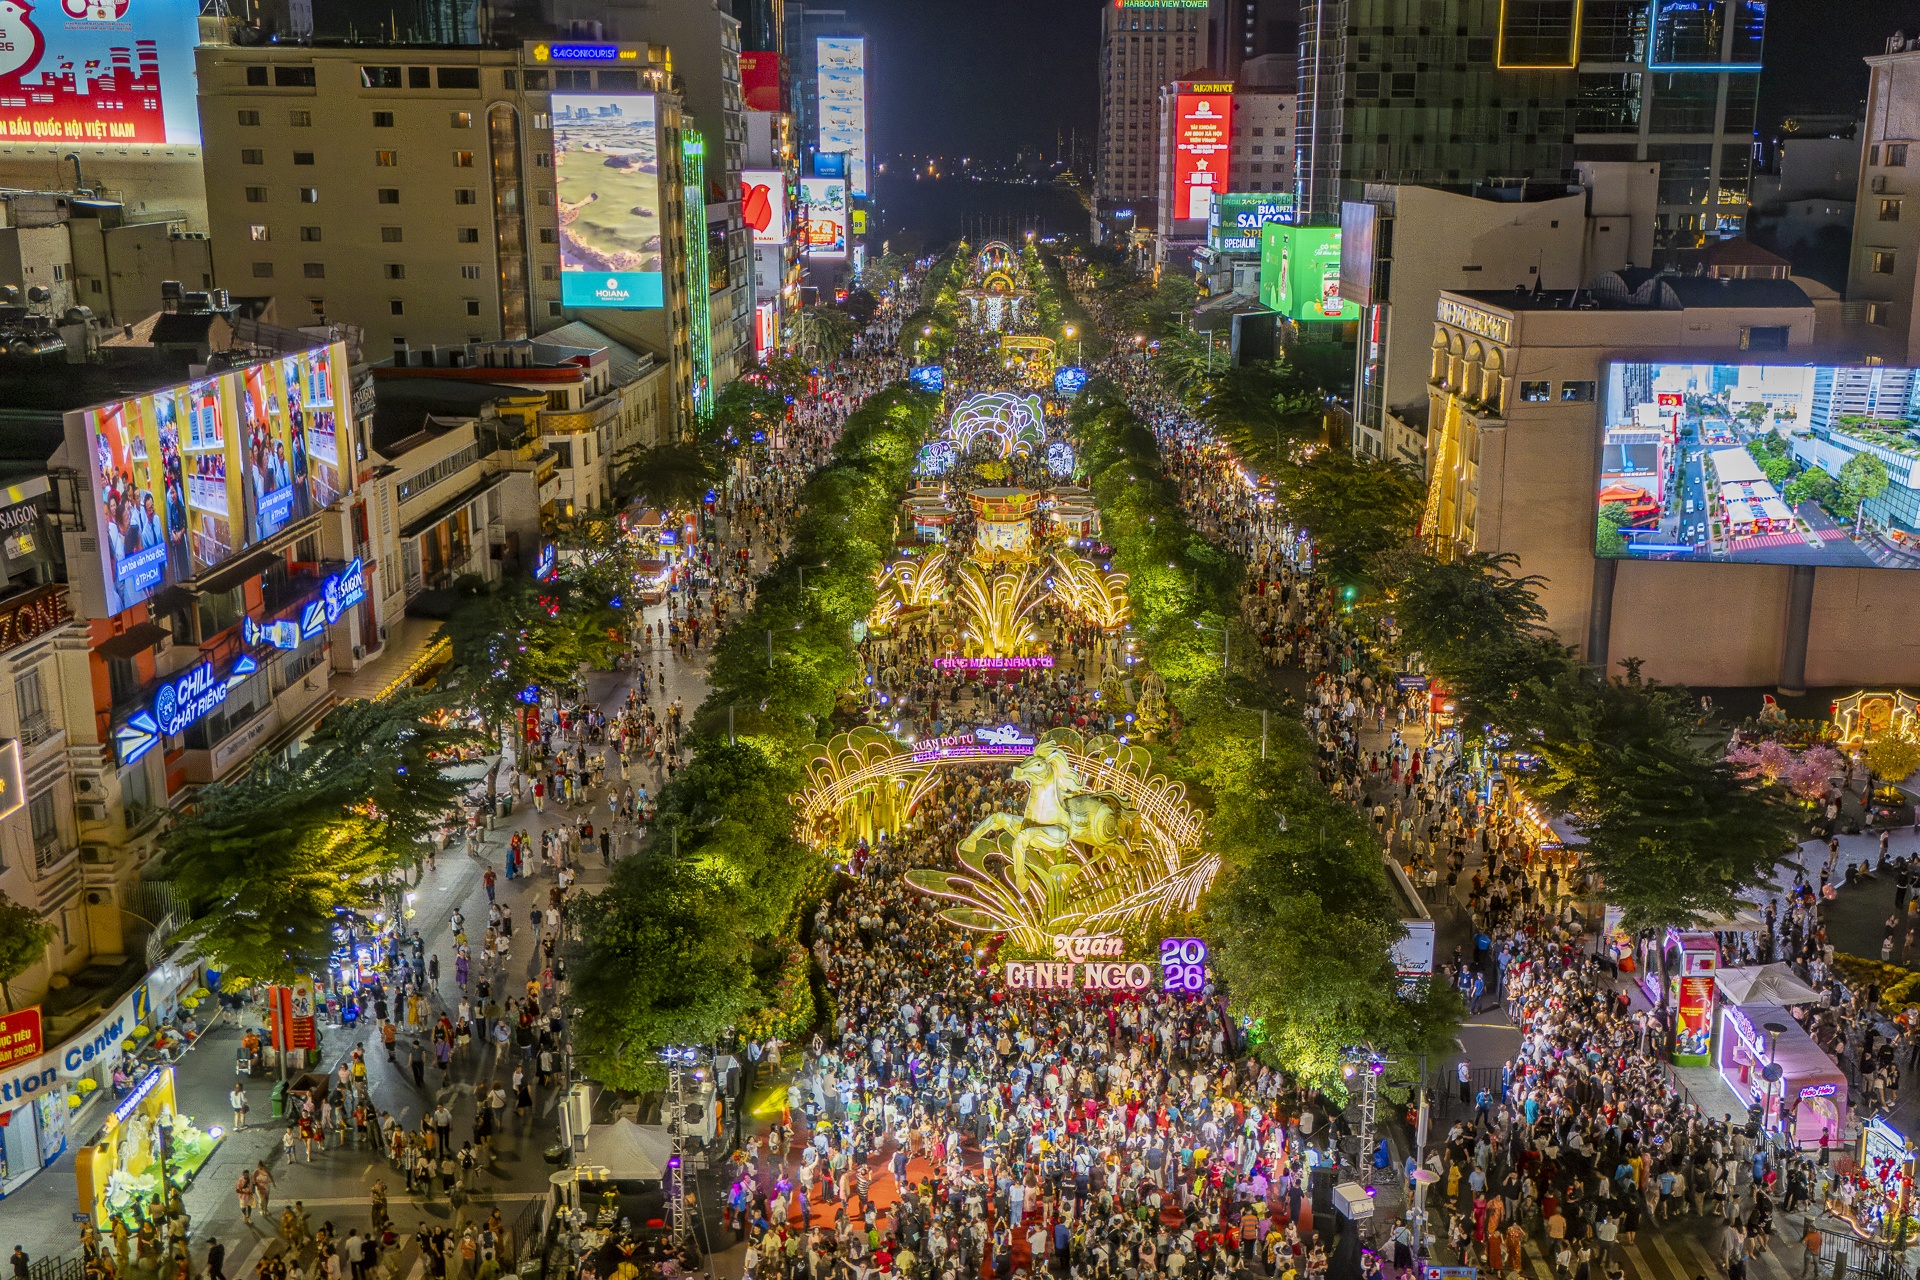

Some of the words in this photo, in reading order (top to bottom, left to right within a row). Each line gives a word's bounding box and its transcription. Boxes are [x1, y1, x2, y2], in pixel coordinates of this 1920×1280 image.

[1124, 0, 1159, 8] HARBOUR
[1161, 0, 1179, 8] VIEW
[1182, 0, 1209, 8] TOWER
[553, 48, 616, 58] SAIGONTOURIST
[1193, 83, 1212, 93] SAIGON
[1213, 83, 1233, 93] PRINCE
[9, 117, 31, 136] BẦU
[33, 117, 62, 137] QUỐC
[64, 119, 83, 139] HỘI
[84, 120, 107, 140] VIỆT
[109, 122, 136, 138] NAM
[1258, 206, 1275, 214] BIA
[0, 504, 38, 530] SAIGON
[340, 573, 363, 597] SAIGON
[0, 589, 74, 652] ZONE
[1005, 656, 1031, 668] NĂM
[177, 662, 214, 706] CHILL
[169, 699, 198, 736] CHẤT
[197, 683, 227, 717] RIÊNG
[912, 739, 939, 752] XUÂN
[942, 734, 958, 748] HỘI
[960, 734, 974, 745] TỤ
[1053, 928, 1123, 963] Xuân
[1160, 938, 1207, 966] 20
[1163, 964, 1205, 991] 26
[14, 1029, 31, 1043] TIÊU
[65, 1013, 125, 1071] Center
[14, 1043, 36, 1058] 2030!
